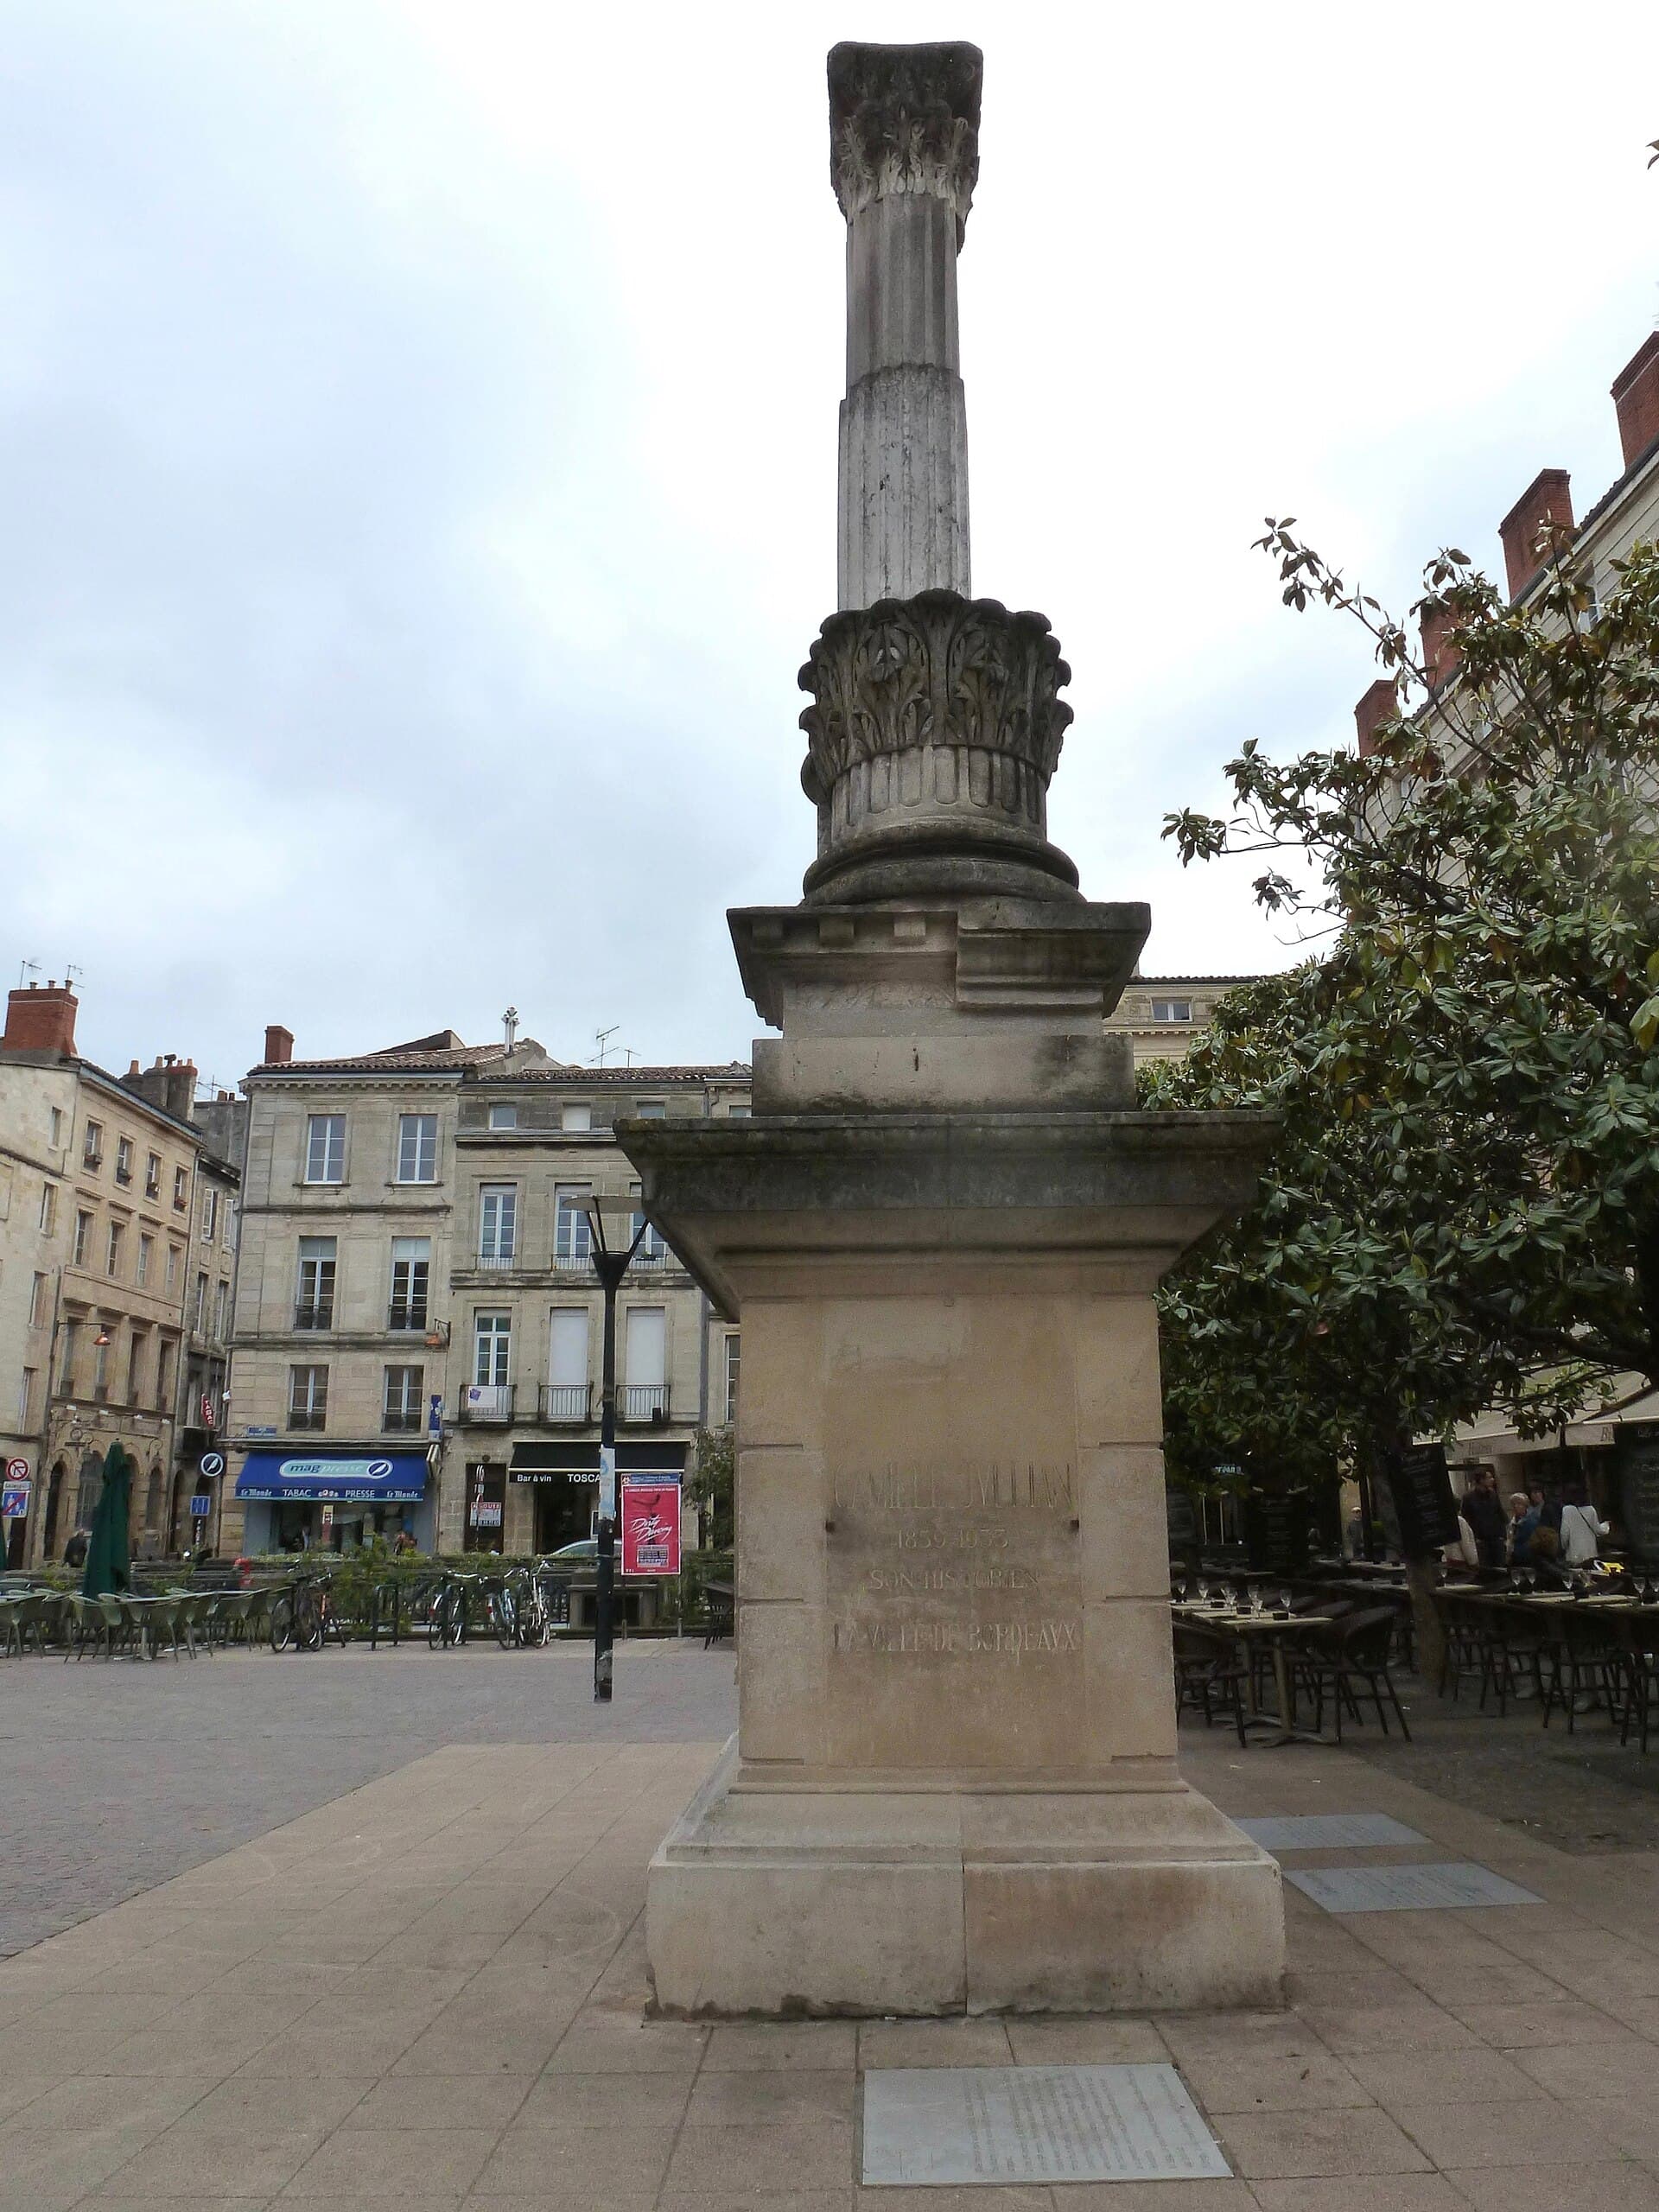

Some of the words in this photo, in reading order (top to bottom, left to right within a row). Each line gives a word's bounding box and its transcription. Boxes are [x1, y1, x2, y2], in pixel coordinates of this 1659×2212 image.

[517, 1474, 531, 1483] Bar
[540, 1474, 551, 1483] vin
[283, 1489, 311, 1497] TABAC
[346, 1490, 375, 1498] PRESSE
[628, 1515, 663, 1533] Dirty
[632, 1525, 672, 1542] Dancing
[870, 1569, 913, 1590] SON
